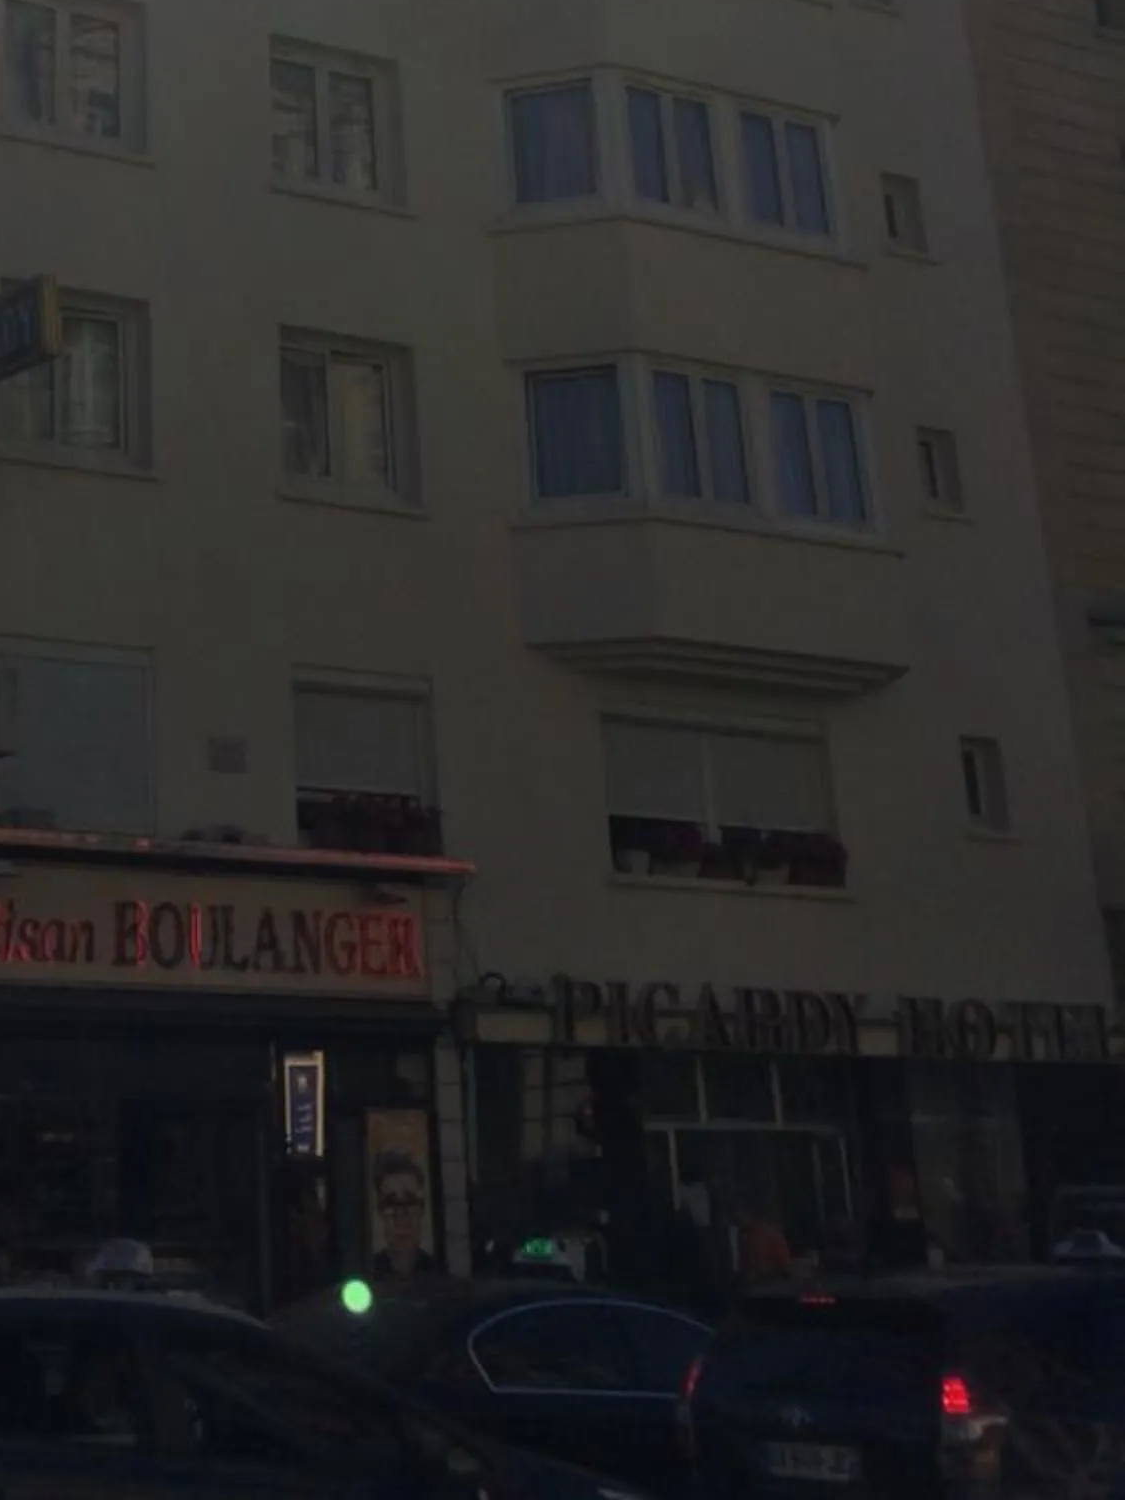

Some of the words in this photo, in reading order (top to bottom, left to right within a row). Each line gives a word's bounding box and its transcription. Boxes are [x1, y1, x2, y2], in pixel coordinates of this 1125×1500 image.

[111, 897, 427, 978] BOULANGER
[556, 978, 863, 1057] PICARDY
[896, 996, 1111, 1063] HOTEL
